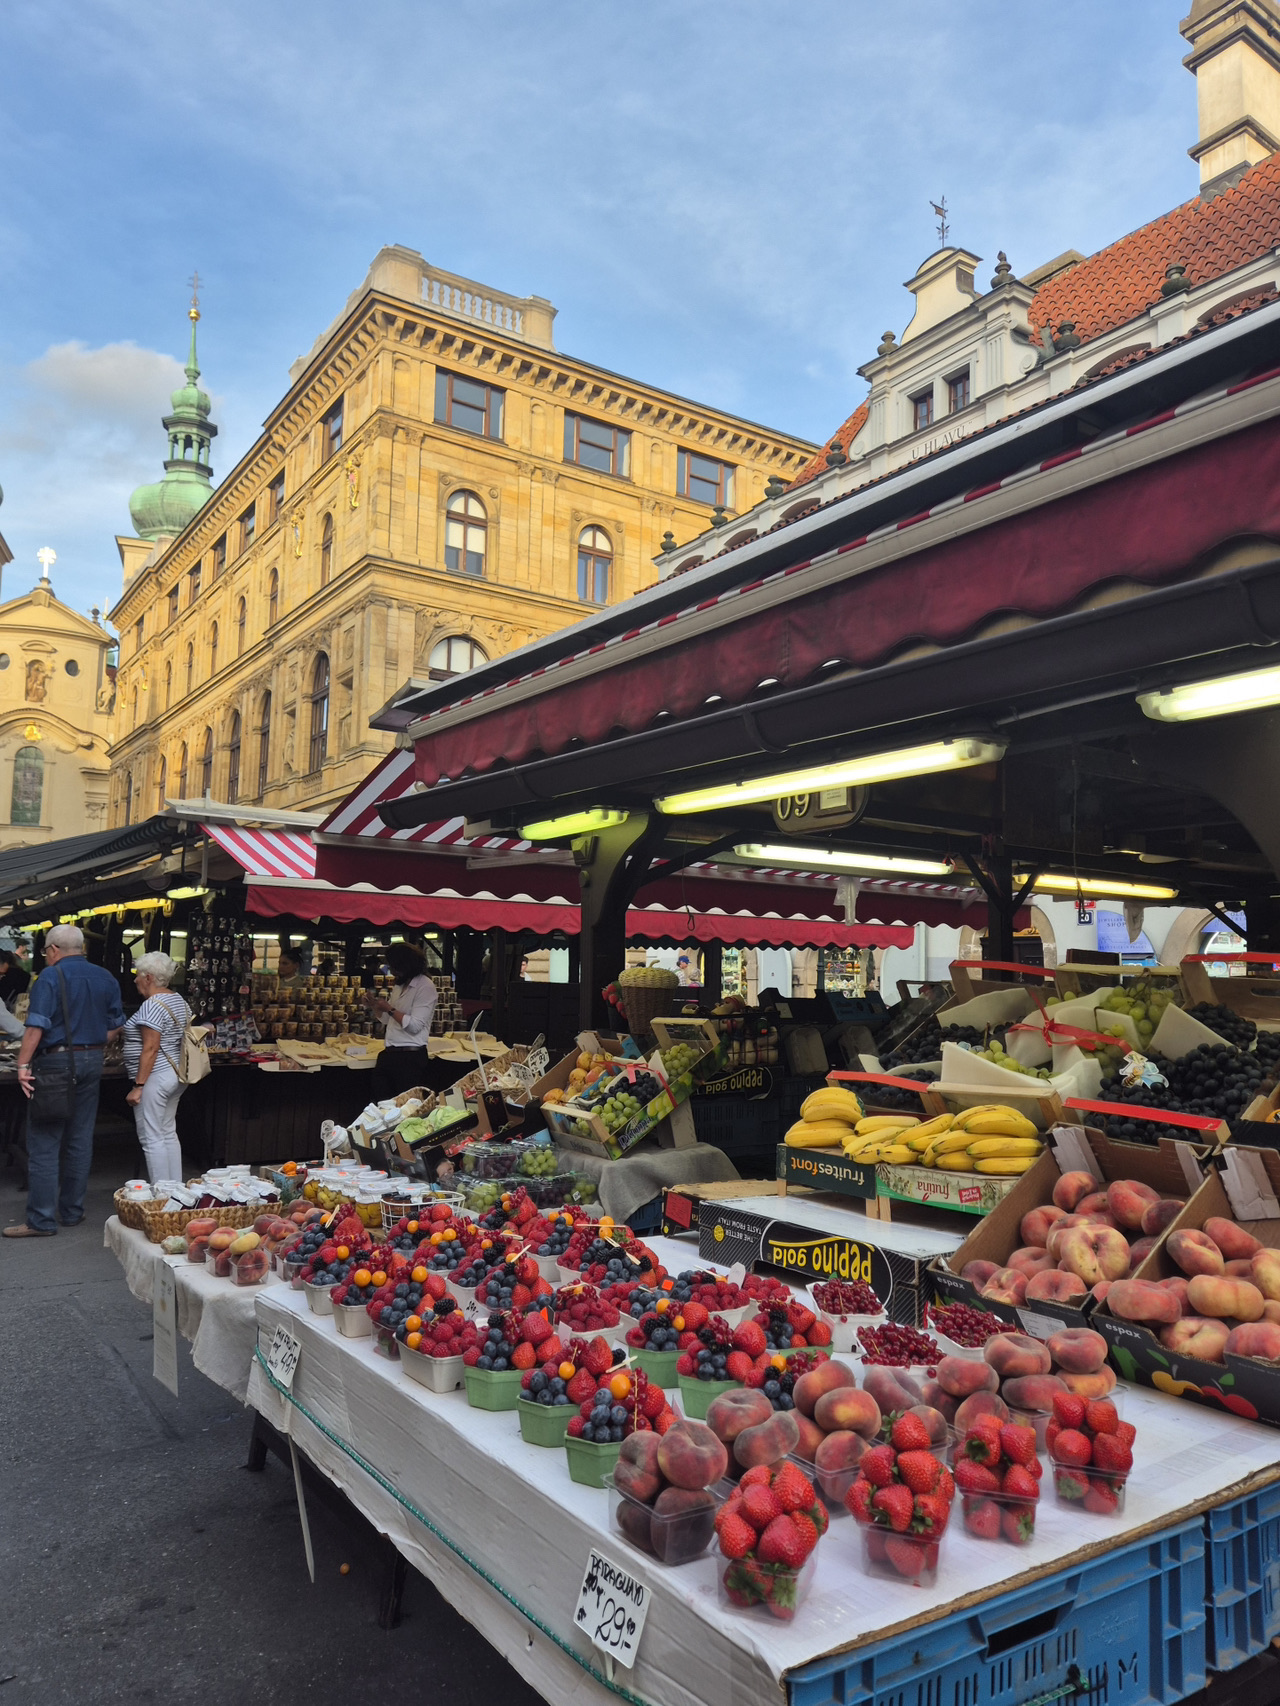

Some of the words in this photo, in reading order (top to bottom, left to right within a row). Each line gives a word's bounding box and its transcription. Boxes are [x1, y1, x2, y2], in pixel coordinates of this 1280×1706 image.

[706, 1081, 728, 1094] gold
[790, 1156, 865, 1186] fruitesfont
[917, 1179, 950, 1199] frutina
[718, 1217, 731, 1226] ITALY
[731, 1221, 746, 1230] FROM
[726, 1230, 744, 1240] BETTER
[747, 1225, 762, 1235] TASTE
[773, 1246, 807, 1268] gold
[936, 1276, 966, 1290] espax
[1105, 1322, 1142, 1340] espax
